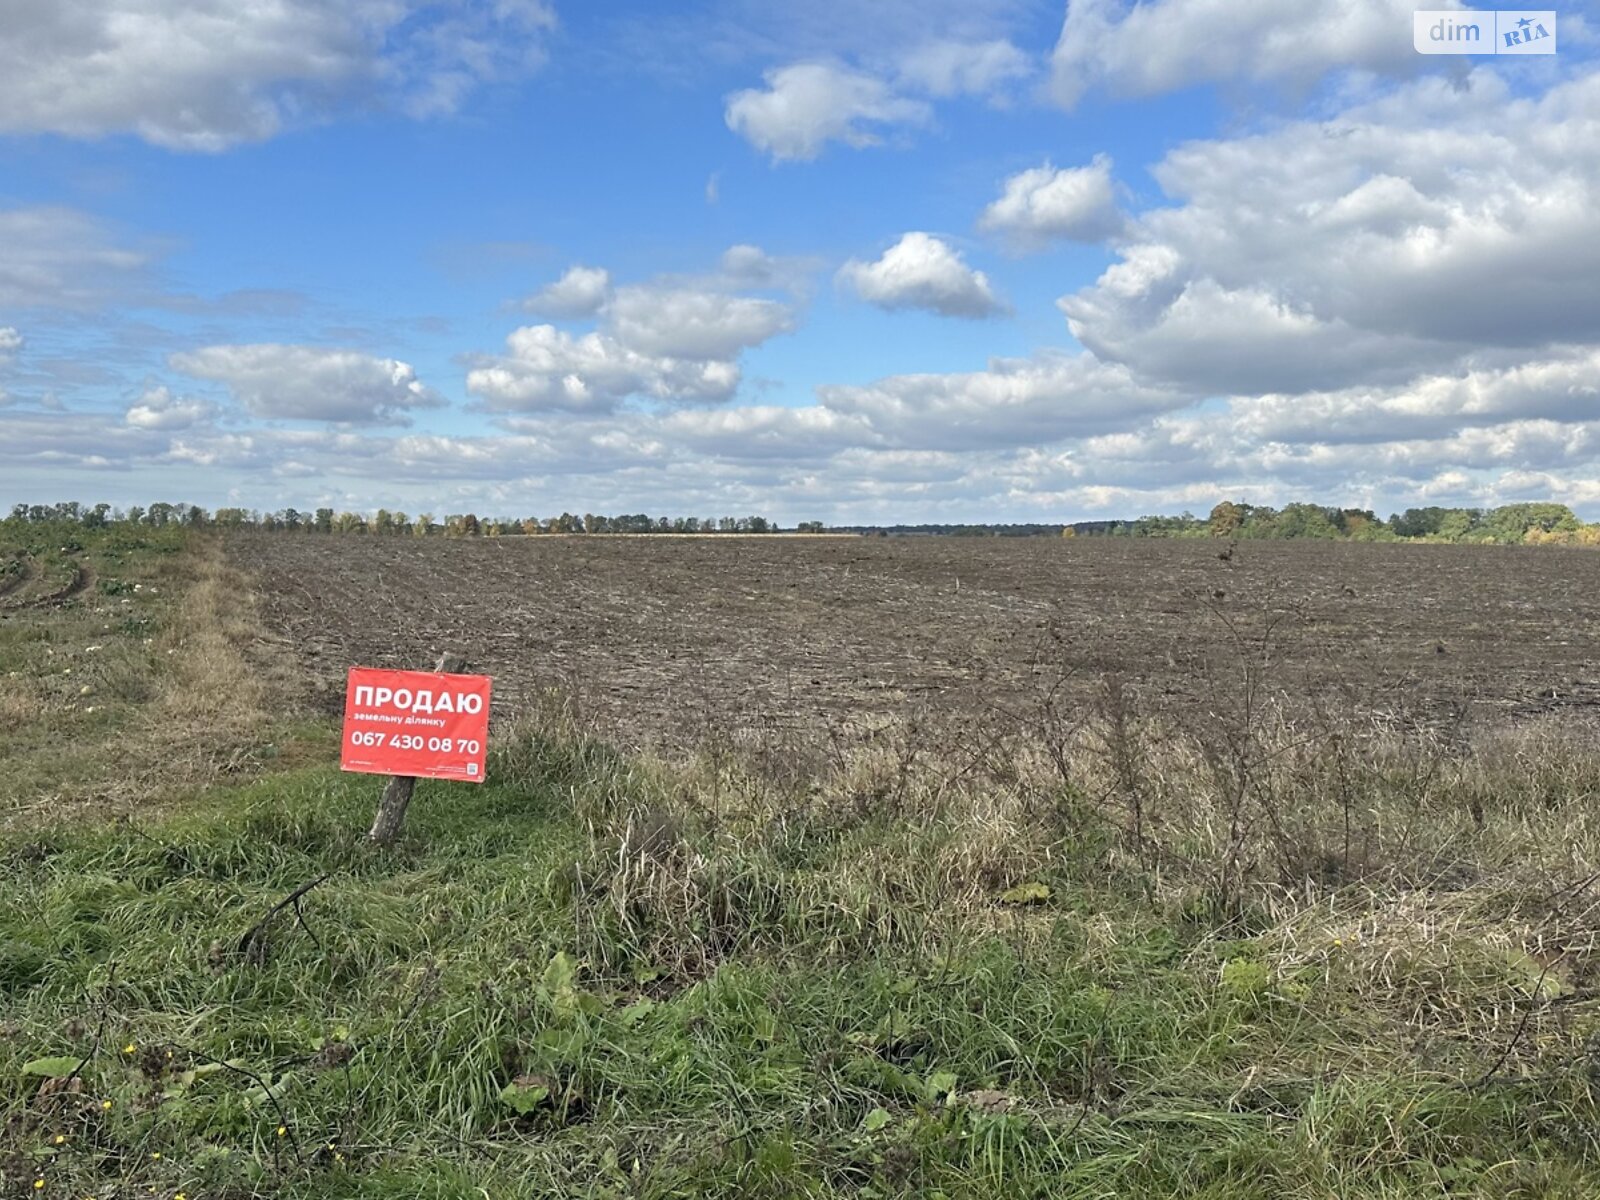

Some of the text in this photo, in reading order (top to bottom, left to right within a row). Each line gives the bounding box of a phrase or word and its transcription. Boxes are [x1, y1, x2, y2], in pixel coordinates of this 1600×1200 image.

[355, 685, 482, 714] ПРОДАЮ
[353, 713, 446, 728] земельну ділянку
[351, 731, 480, 755] 067 430 08 70
